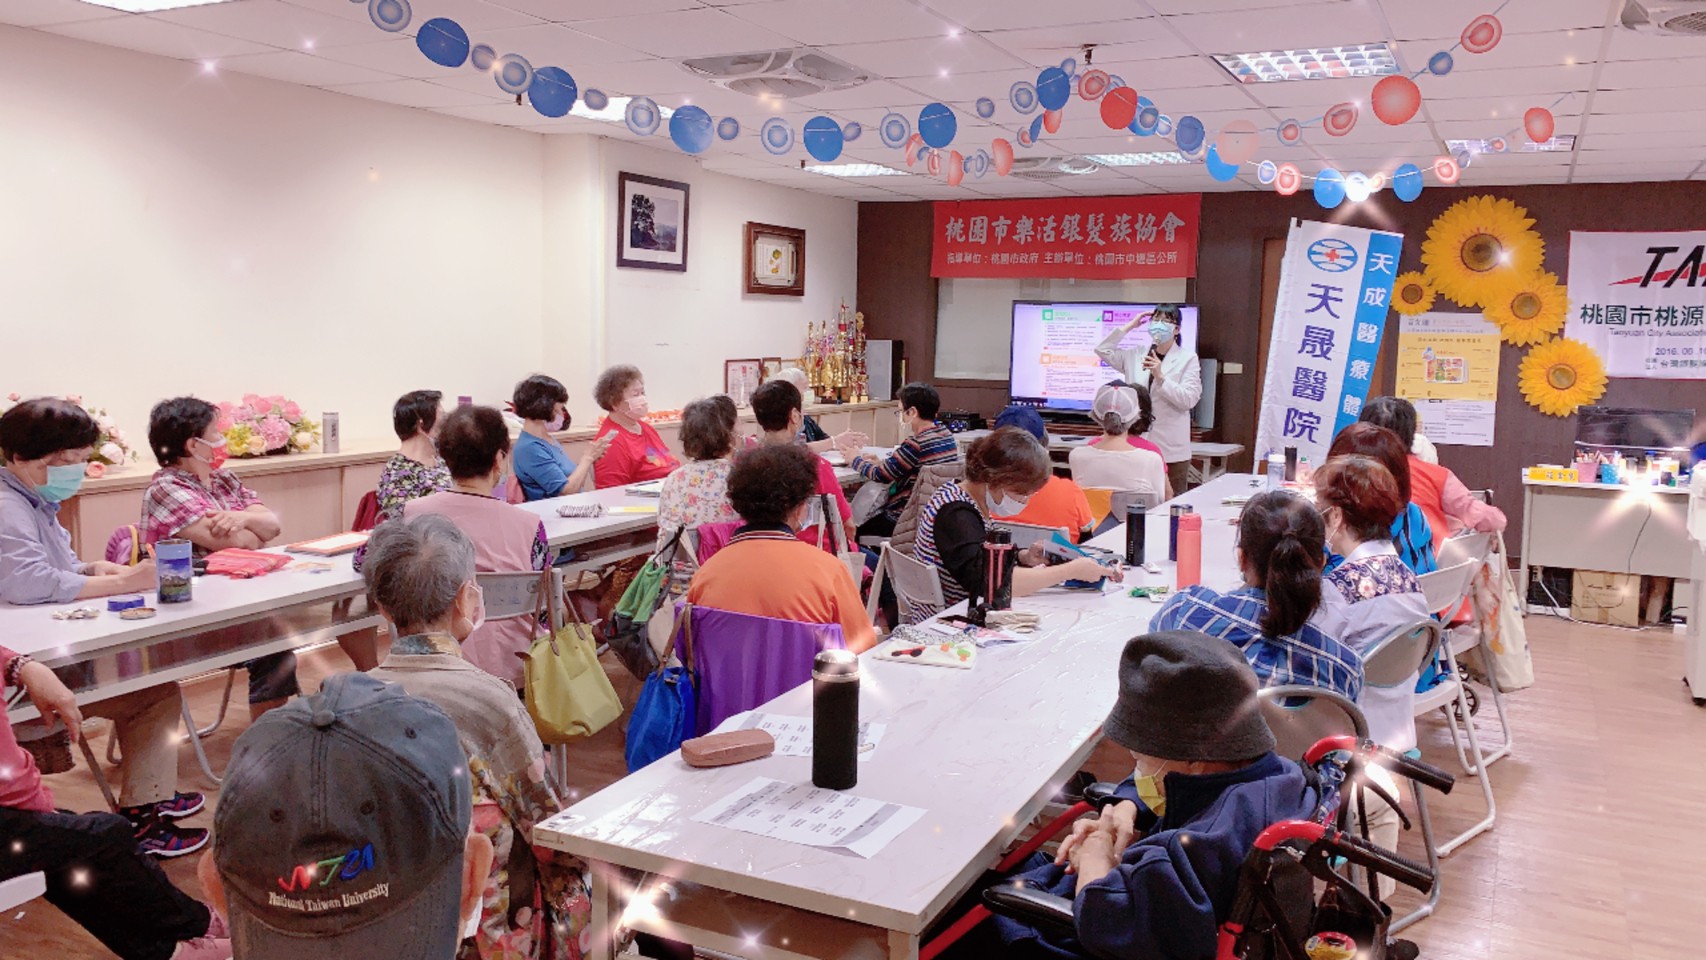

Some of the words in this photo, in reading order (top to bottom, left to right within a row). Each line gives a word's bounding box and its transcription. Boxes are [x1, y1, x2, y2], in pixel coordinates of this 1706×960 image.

[945, 211, 1186, 246] 桃園市樂活銀髮族協會
[1639, 245, 1706, 288] TA
[1282, 283, 1344, 444] 天晟醫院
[268, 891, 305, 912] National
[305, 899, 341, 912] Taiwan
[341, 883, 389, 908] University
